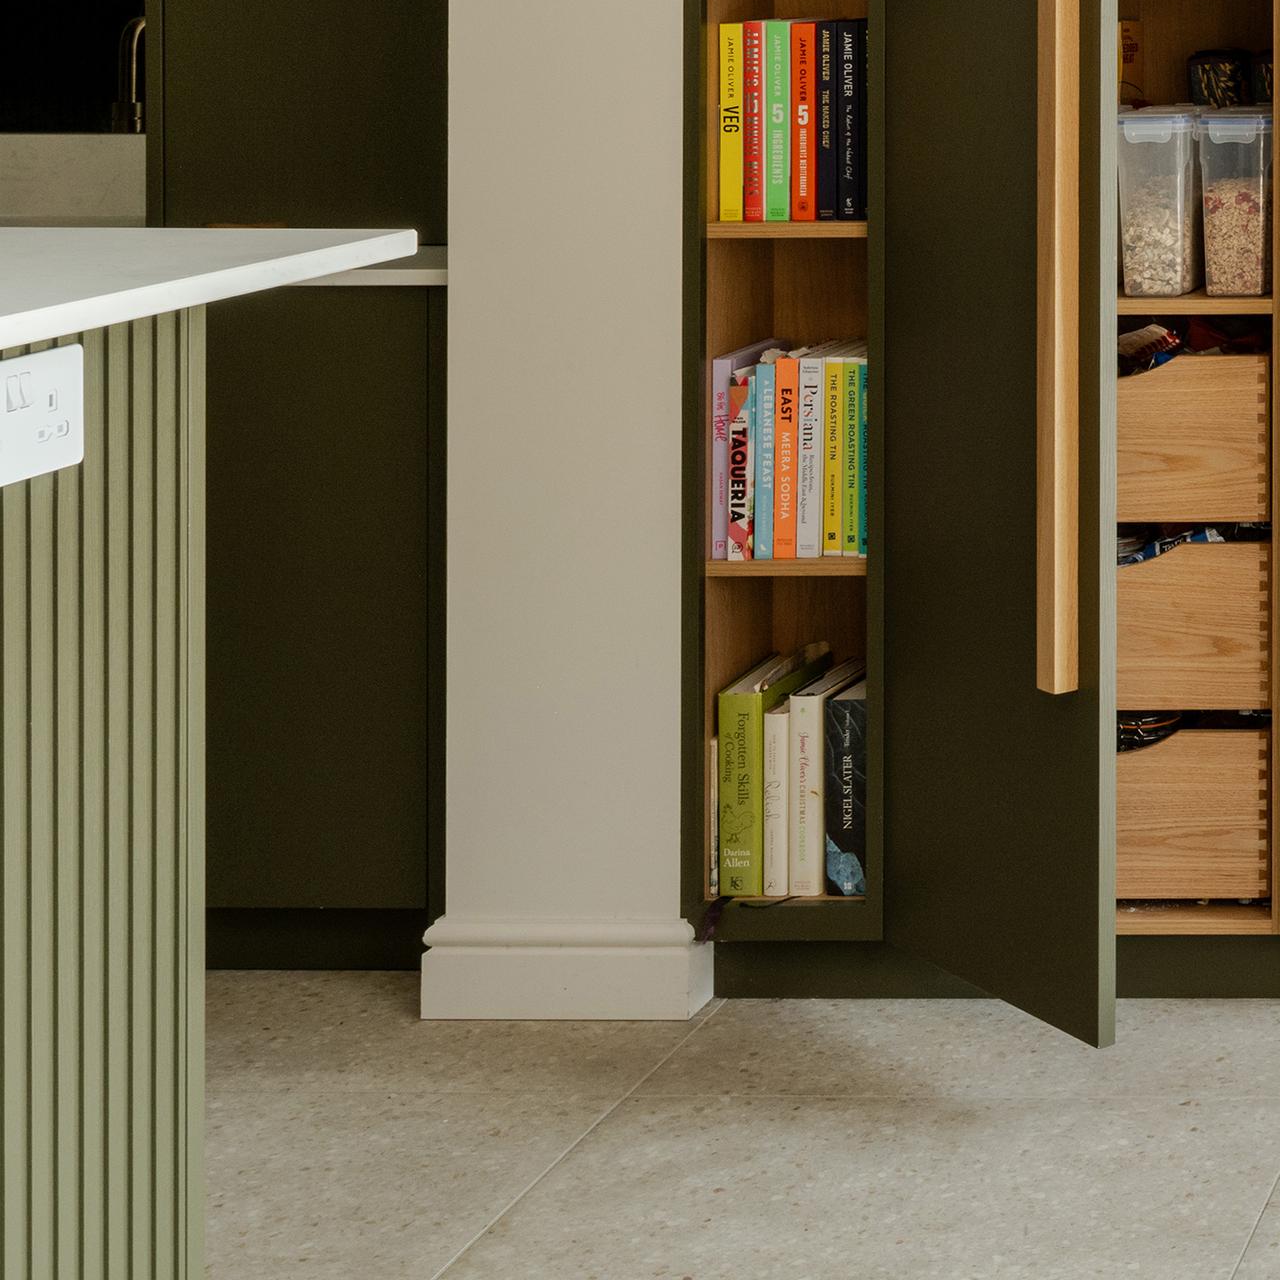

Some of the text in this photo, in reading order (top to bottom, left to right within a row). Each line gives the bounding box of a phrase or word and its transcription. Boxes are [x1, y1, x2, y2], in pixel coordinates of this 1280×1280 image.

[774, 34, 782, 96] JAMIE OLIVER
[799, 38, 807, 101] JAMIE OLIVER
[843, 32, 853, 97] JAMIE OLIVER
[723, 106, 739, 133] VEG
[772, 103, 784, 123] 5
[798, 105, 809, 125] 5
[772, 130, 783, 184] INGREDIENTS
[763, 388, 772, 449] LEBANESE
[803, 384, 818, 450] Persiana
[730, 428, 747, 523] TAQUERIA
[763, 453, 771, 488] FEAST
[780, 388, 791, 519] EAST MEERA SODHA
[723, 742, 733, 783] Cooking
[735, 713, 749, 806] Forgotten Skills
[842, 756, 853, 830] NIGEL SLATER
[723, 848, 750, 856] Darina
[723, 858, 750, 867] Allen
